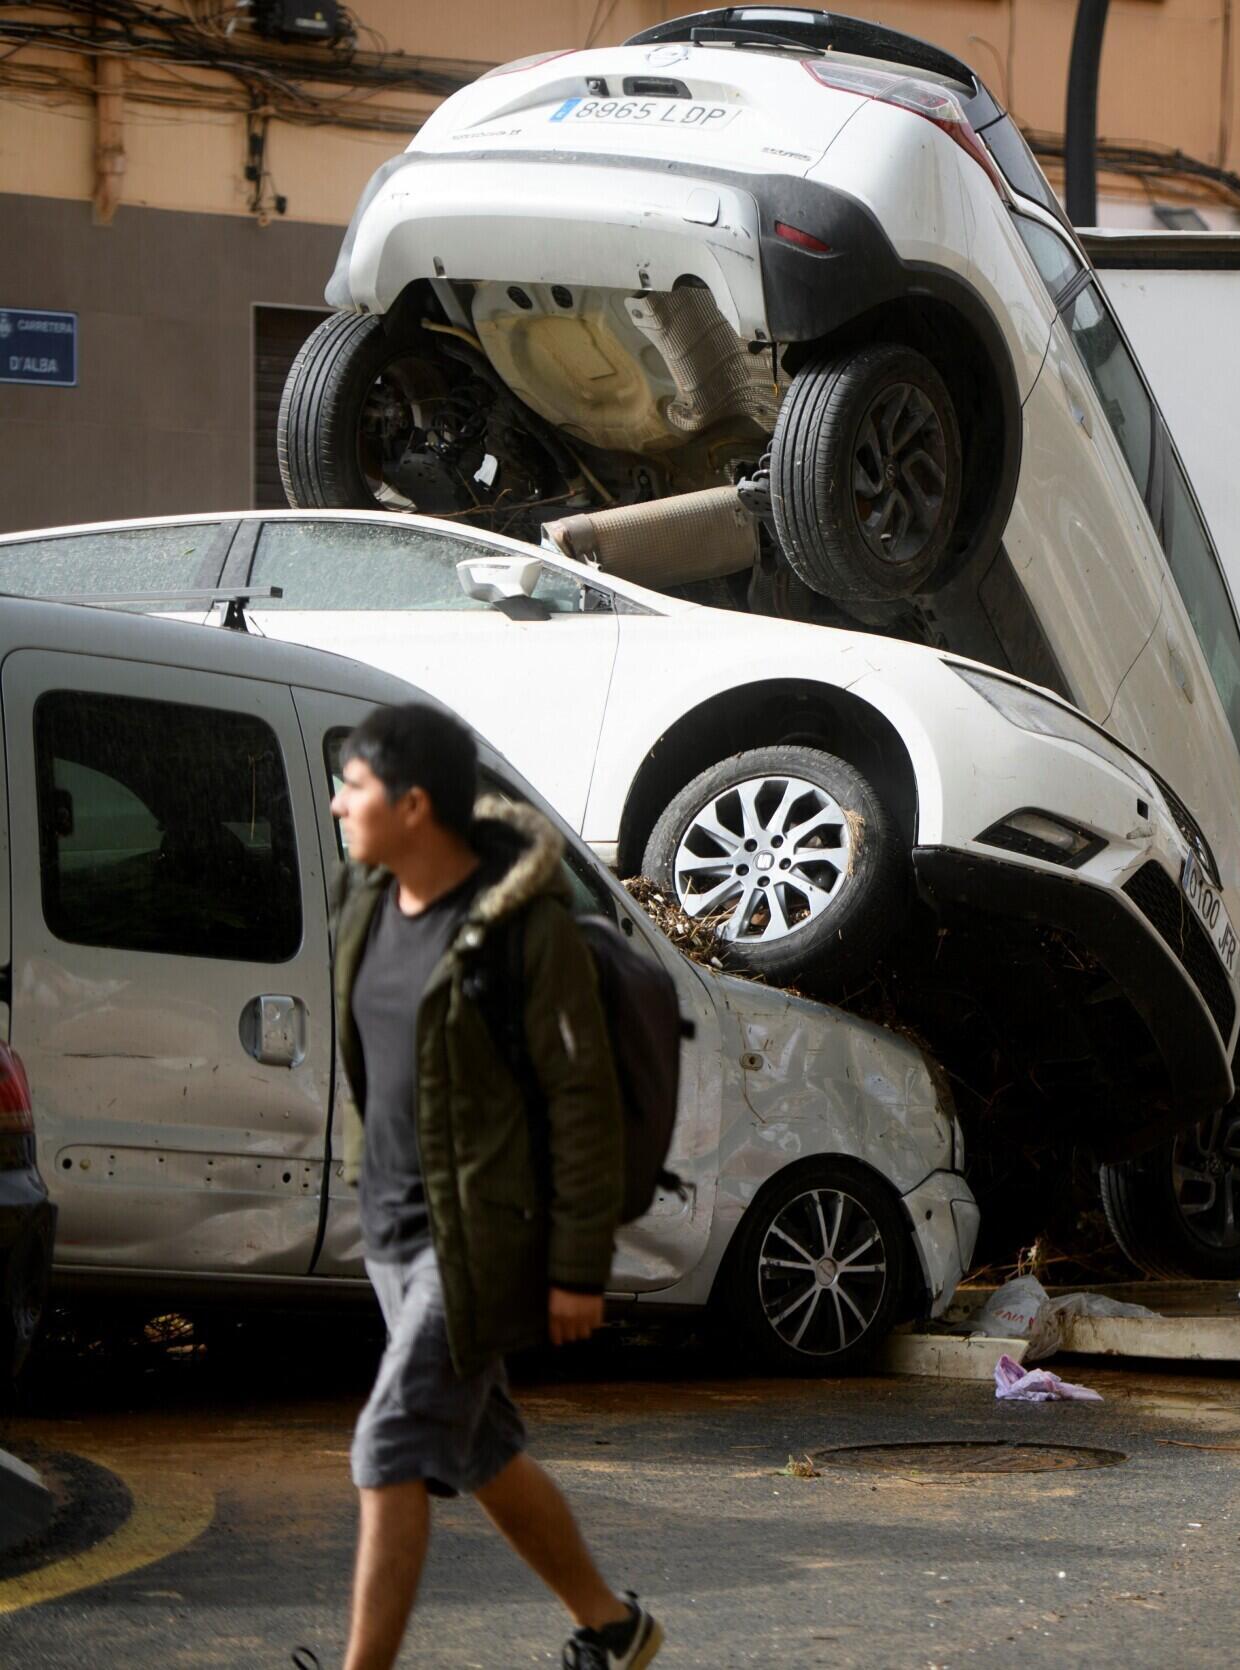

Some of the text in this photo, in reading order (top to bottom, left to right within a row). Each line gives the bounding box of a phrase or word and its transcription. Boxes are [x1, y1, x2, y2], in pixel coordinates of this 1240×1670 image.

[575, 101, 727, 126] 8965 LDP
[17, 319, 73, 334] CARRETERA
[9, 355, 59, 374] D'ALBA
[1189, 868, 1237, 970] 0100 JFR
